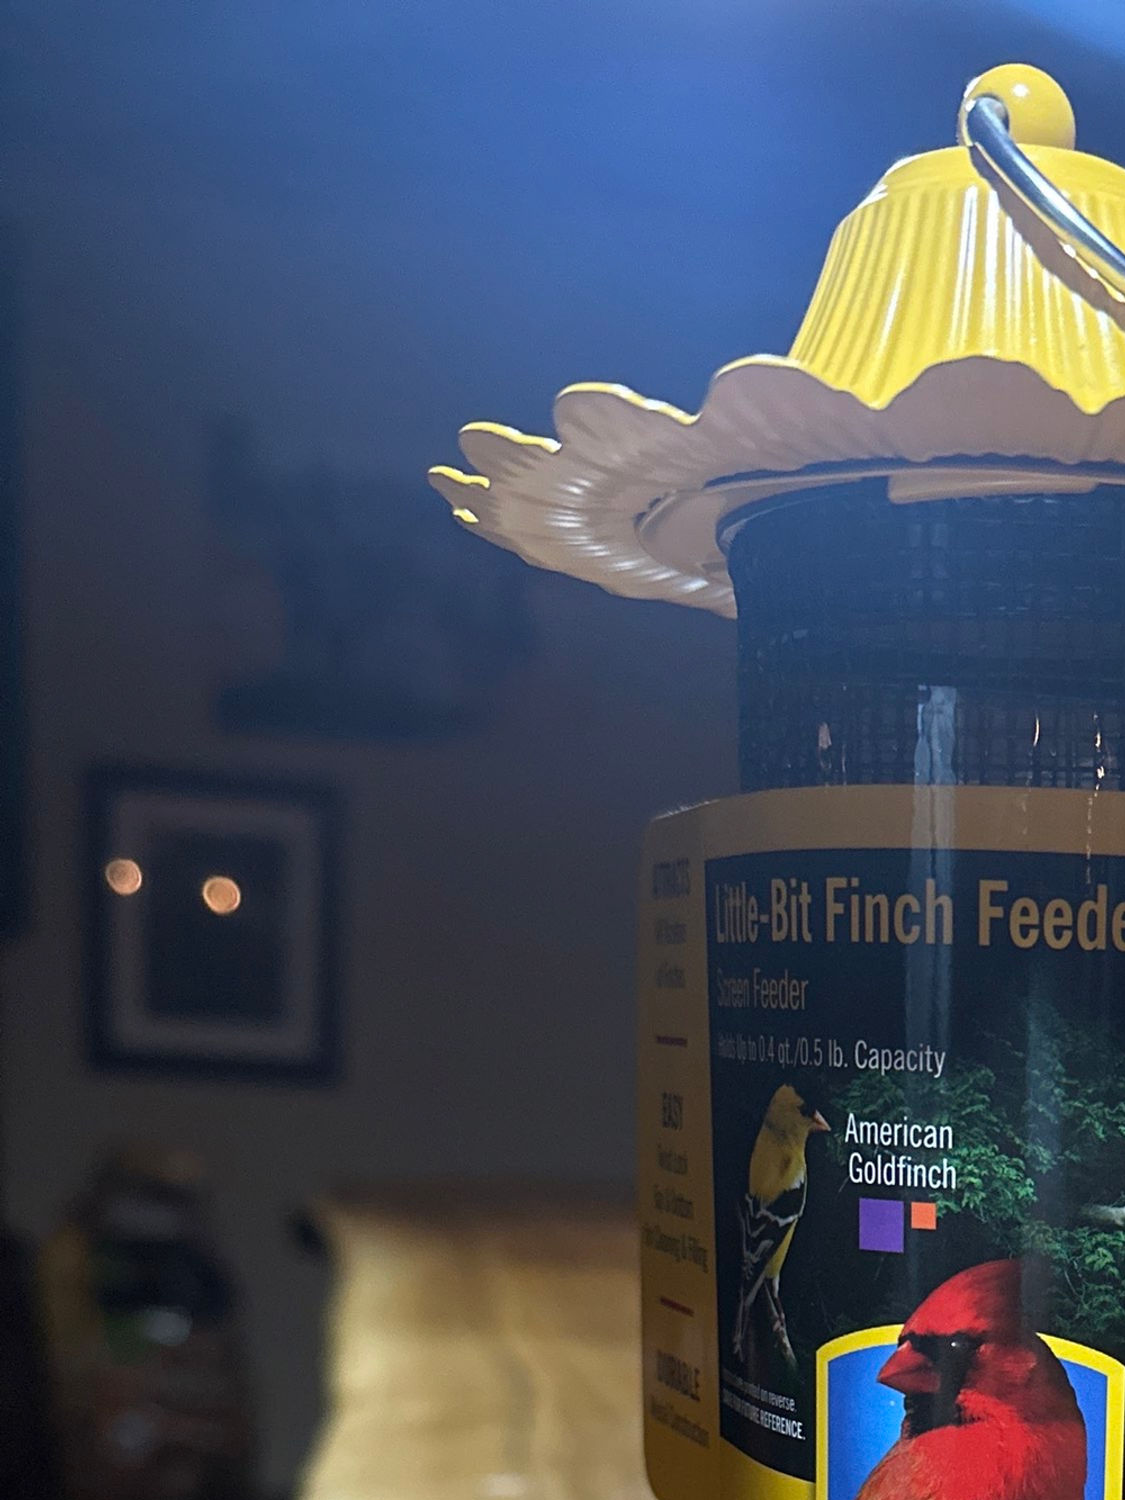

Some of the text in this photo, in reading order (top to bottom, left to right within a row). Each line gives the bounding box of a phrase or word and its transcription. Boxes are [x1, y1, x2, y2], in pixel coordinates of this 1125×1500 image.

[713, 877, 813, 944] Little-Bit
[826, 876, 954, 945] Finch
[717, 967, 750, 1008] Screen
[753, 968, 809, 1010] Feeder
[760, 1034, 775, 1063] 0.4
[828, 1039, 848, 1068] lb.
[854, 1039, 947, 1078] Capacity
[844, 1112, 953, 1150] American
[848, 1152, 958, 1190] Goldfinch
[760, 1408, 806, 1441] REFERENCE.
